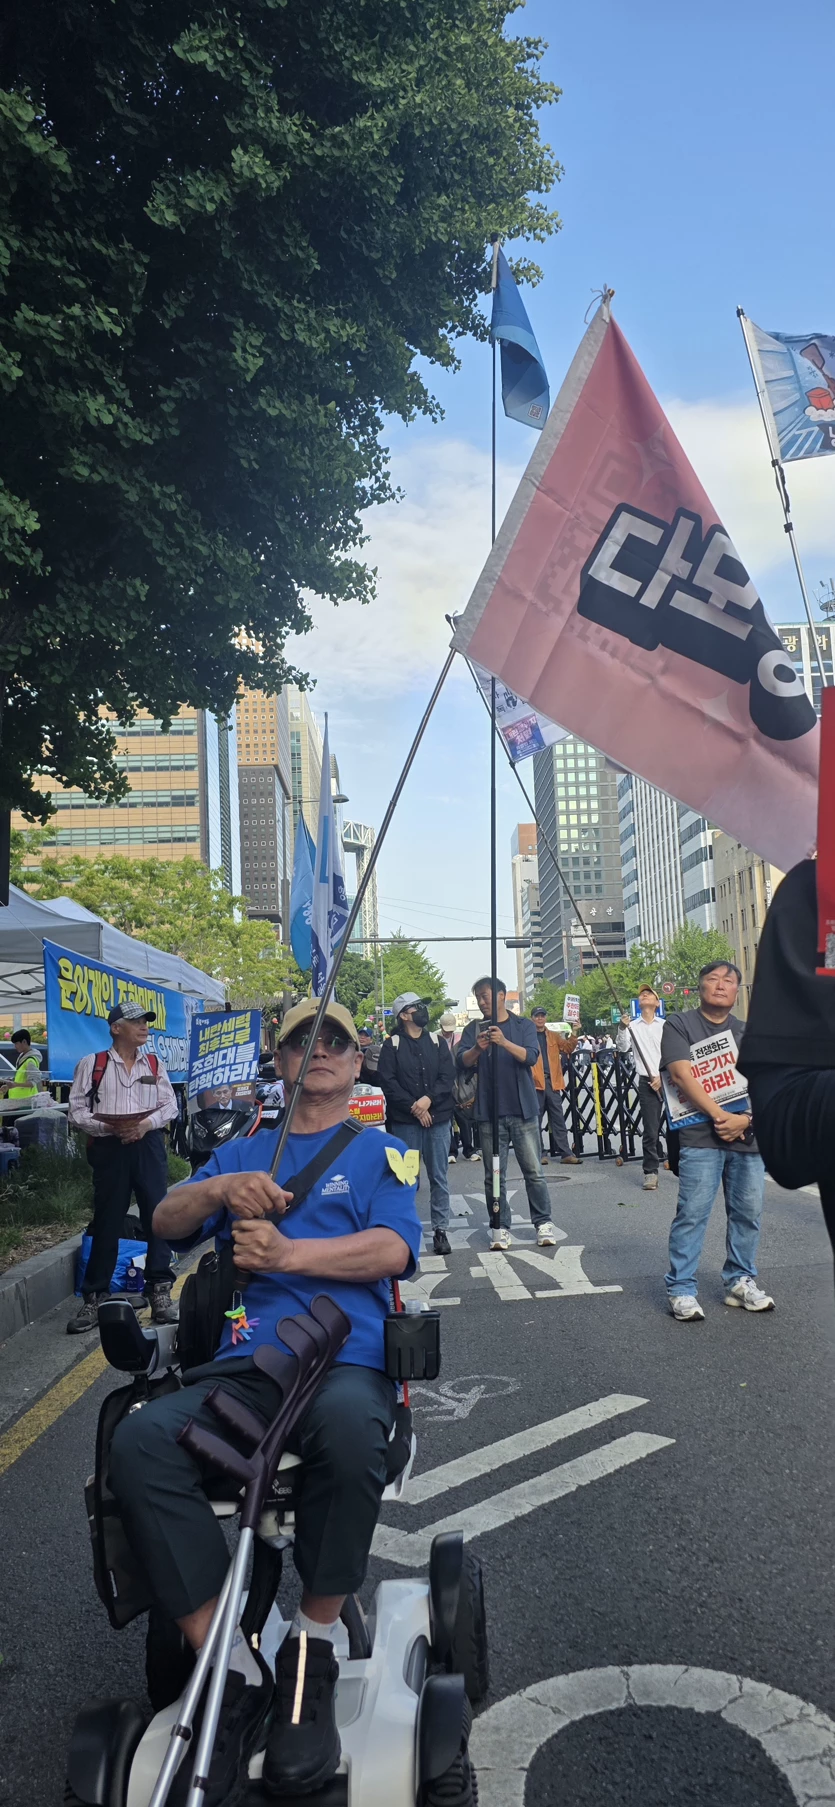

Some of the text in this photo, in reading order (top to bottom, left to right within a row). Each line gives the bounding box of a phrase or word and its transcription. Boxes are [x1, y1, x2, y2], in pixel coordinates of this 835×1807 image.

[199, 1011, 251, 1042] 내란세력
[198, 1028, 251, 1057] 최후보루
[695, 1038, 730, 1059] 전쟁화근
[191, 1041, 256, 1077] 조희대를
[188, 1060, 258, 1100] 탄핵하라!
